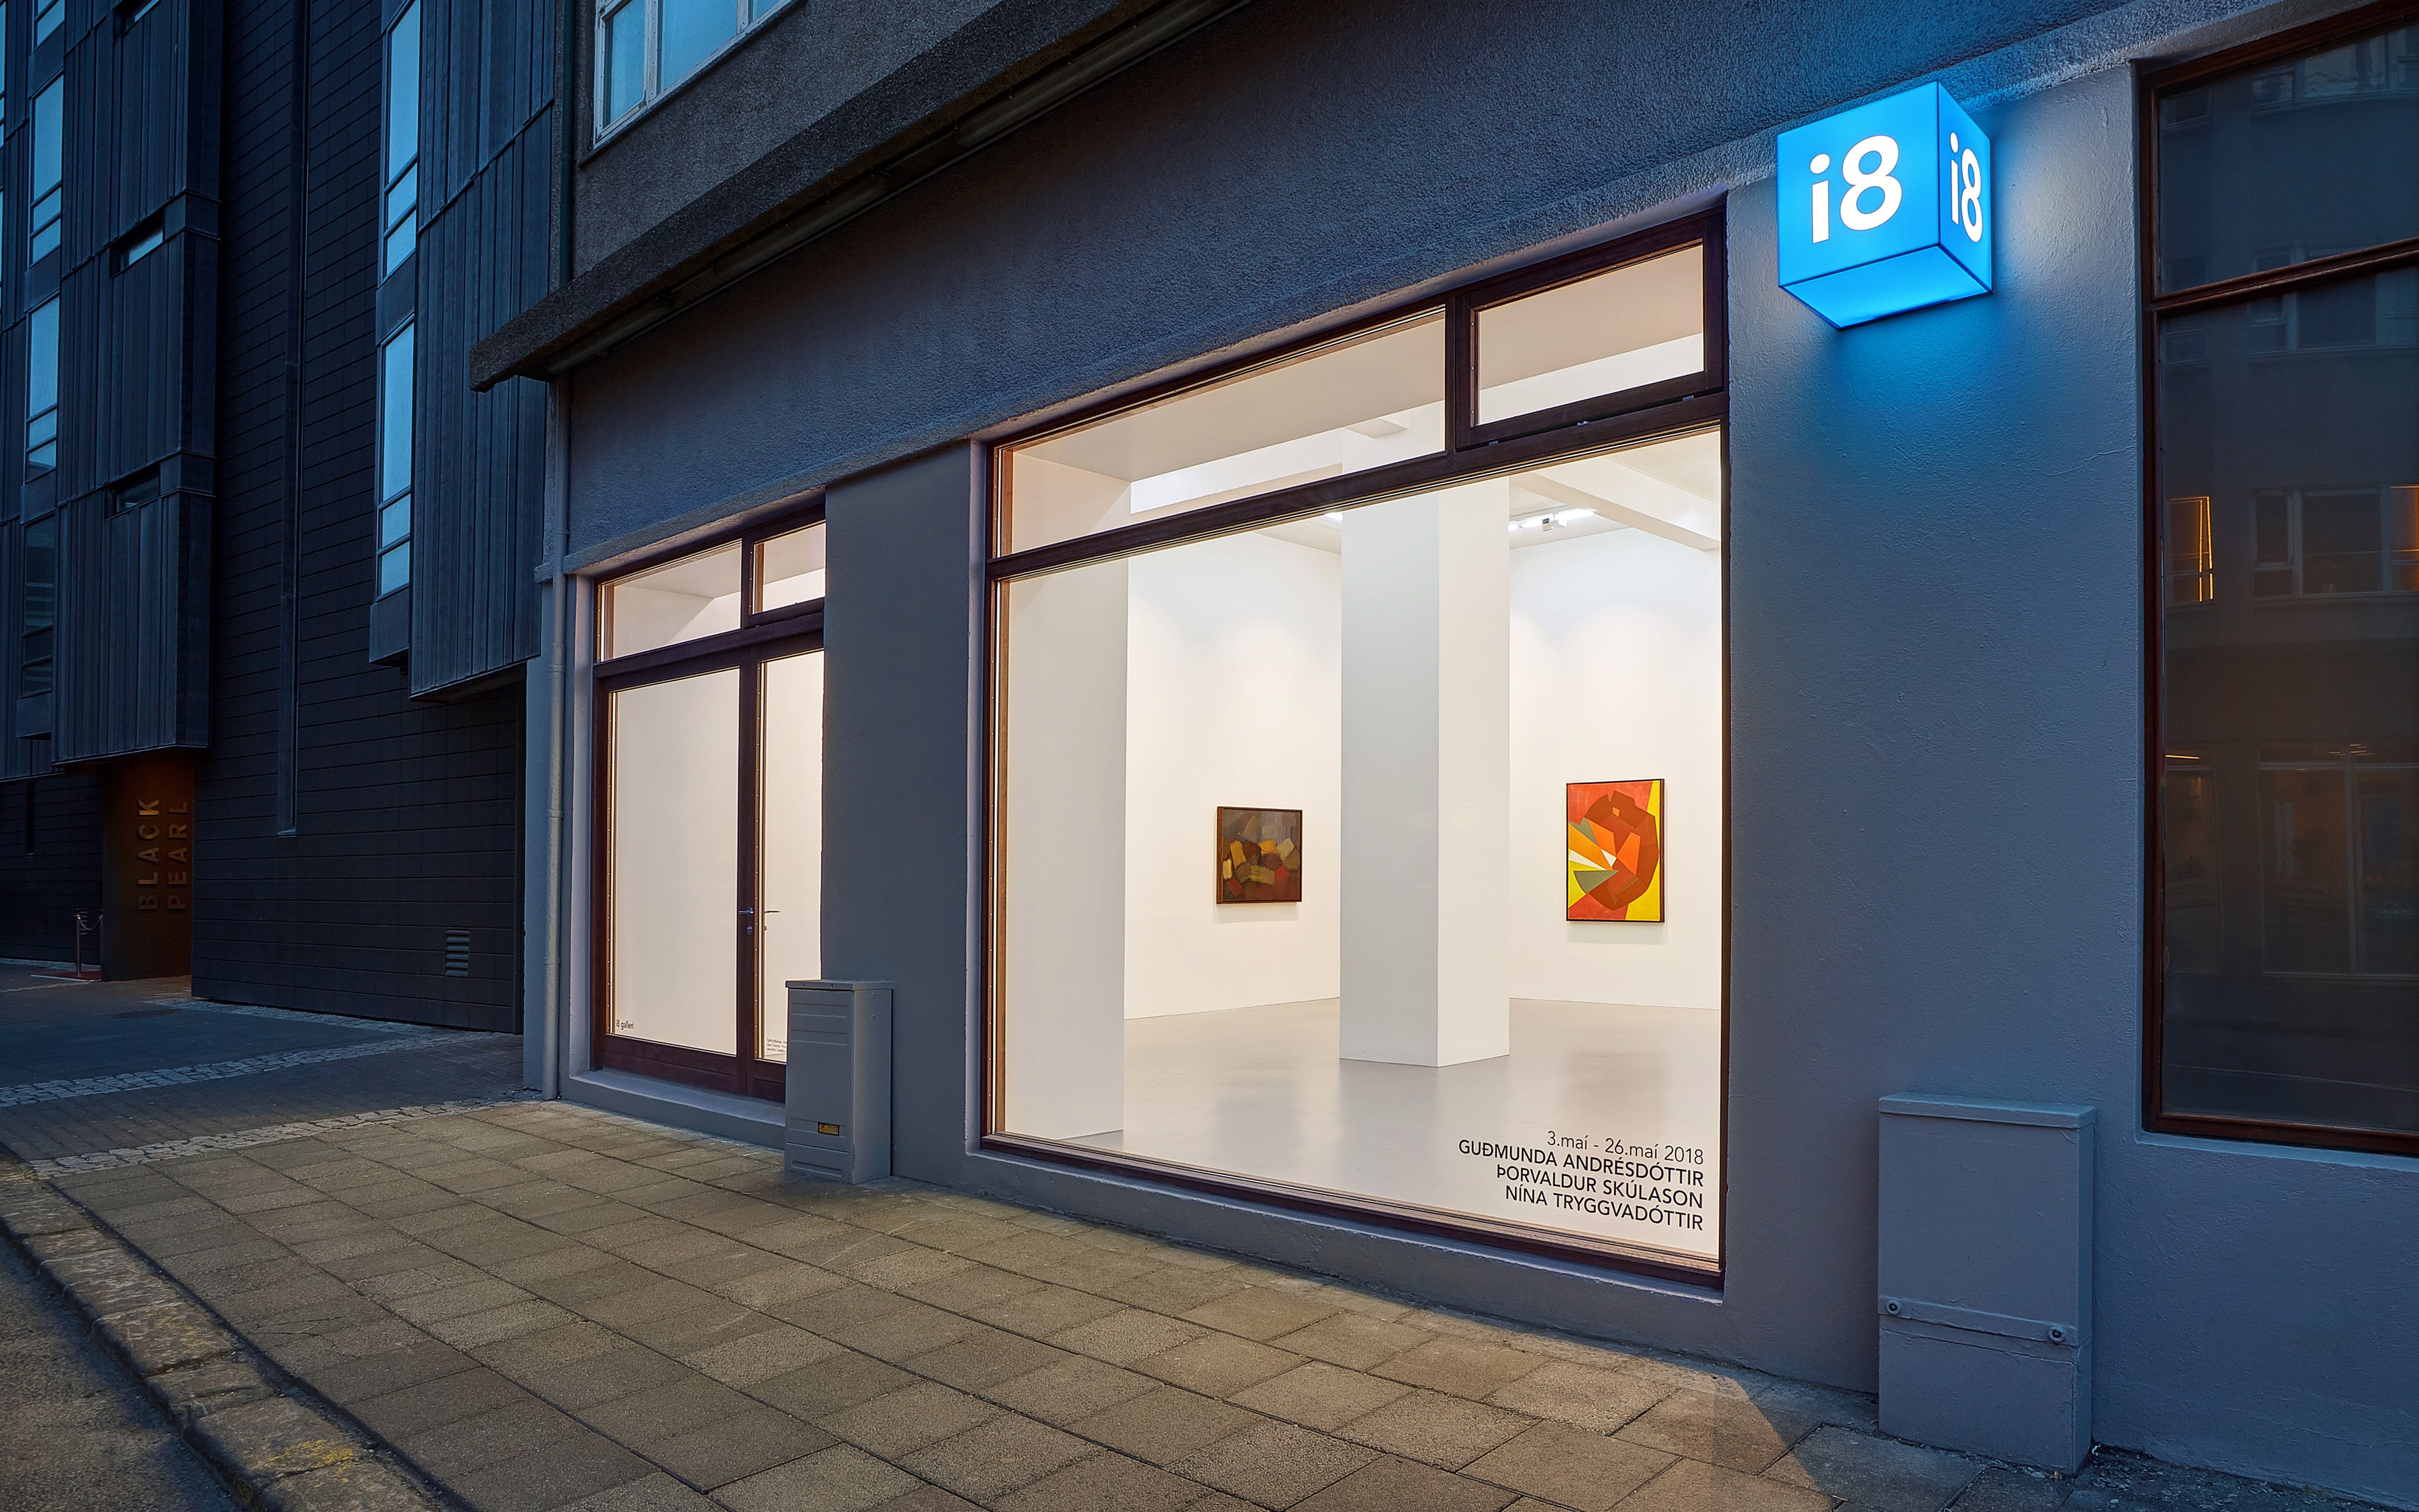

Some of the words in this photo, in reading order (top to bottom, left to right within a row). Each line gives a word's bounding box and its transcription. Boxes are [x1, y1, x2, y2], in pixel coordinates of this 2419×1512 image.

[1810, 135, 1902, 244] i8
[1950, 132, 1983, 242] i8
[137, 799, 160, 910] BLACK
[168, 801, 187, 909] PEARL
[1459, 1139, 1558, 1166] GUÐMUNDA
[1563, 1153, 1703, 1187] ANDRÉSDÓTTIR
[1497, 1164, 1597, 1193] ÞORVALDUR
[1603, 1179, 1702, 1208] SKÚLASON
[1547, 1130, 1589, 1150] 3.maí
[1605, 1137, 1658, 1159] 26.maí
[1664, 1145, 1703, 1165] 2018
[1506, 1183, 1548, 1206] NÍNA
[1553, 1192, 1703, 1231] TRYGGVADÓTTIR
